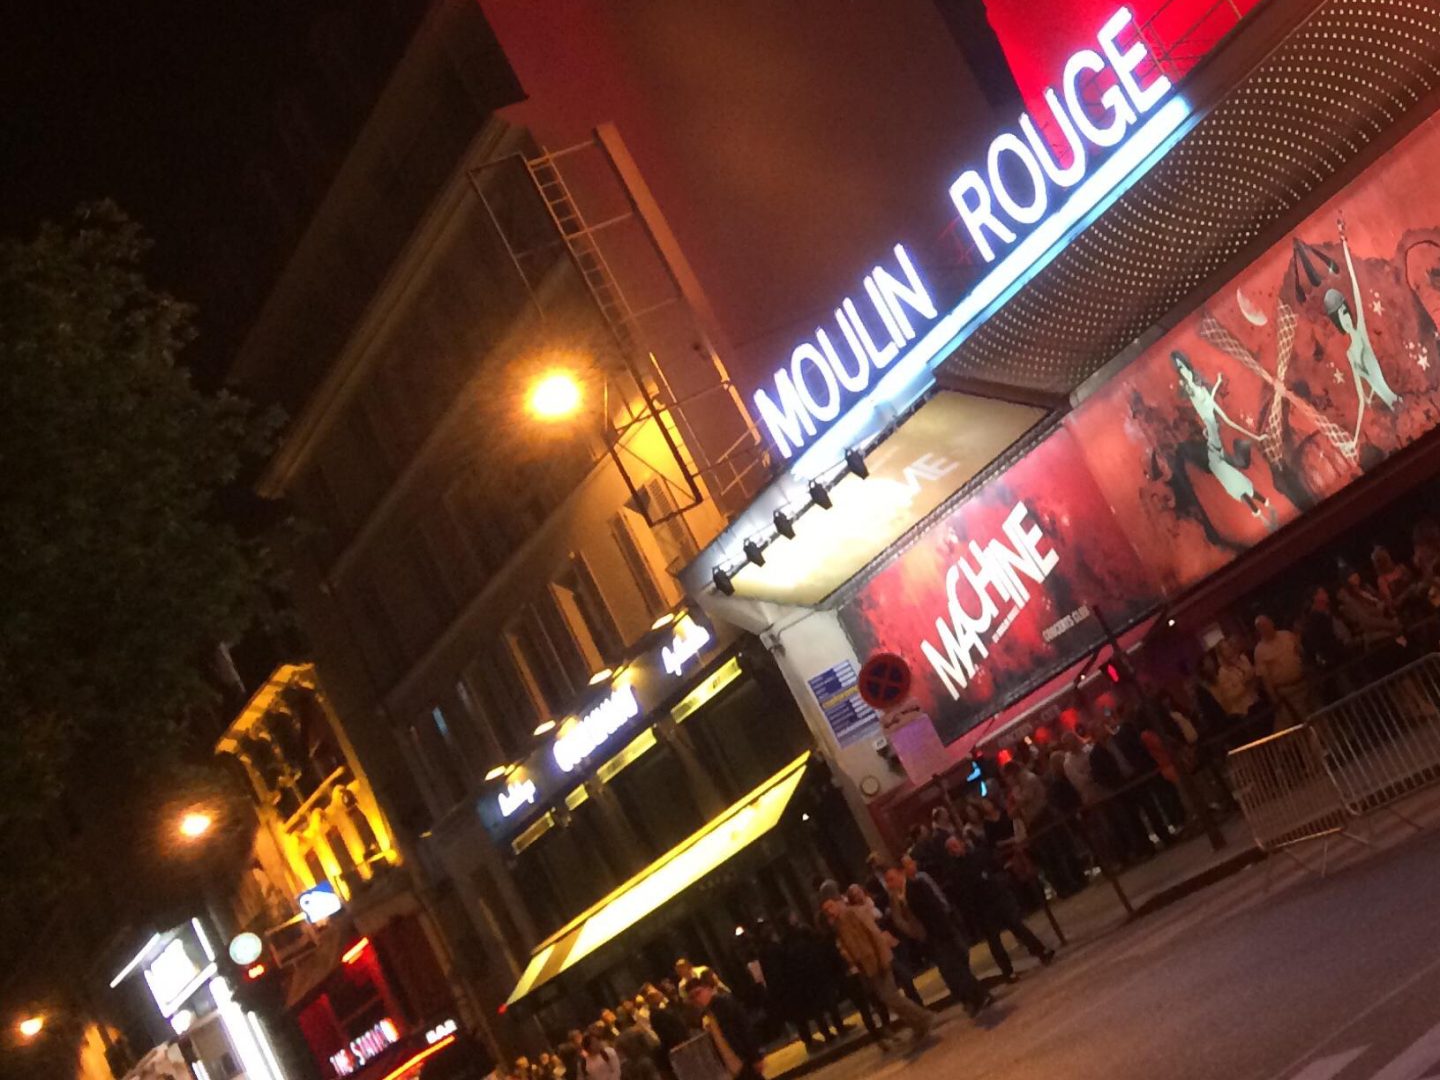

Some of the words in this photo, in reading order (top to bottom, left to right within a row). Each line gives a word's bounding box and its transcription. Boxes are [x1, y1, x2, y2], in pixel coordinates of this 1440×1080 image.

[752, 242, 938, 460] MOULIN
[948, 5, 1174, 262] ROUGE
[920, 500, 1061, 701] MACHINE
